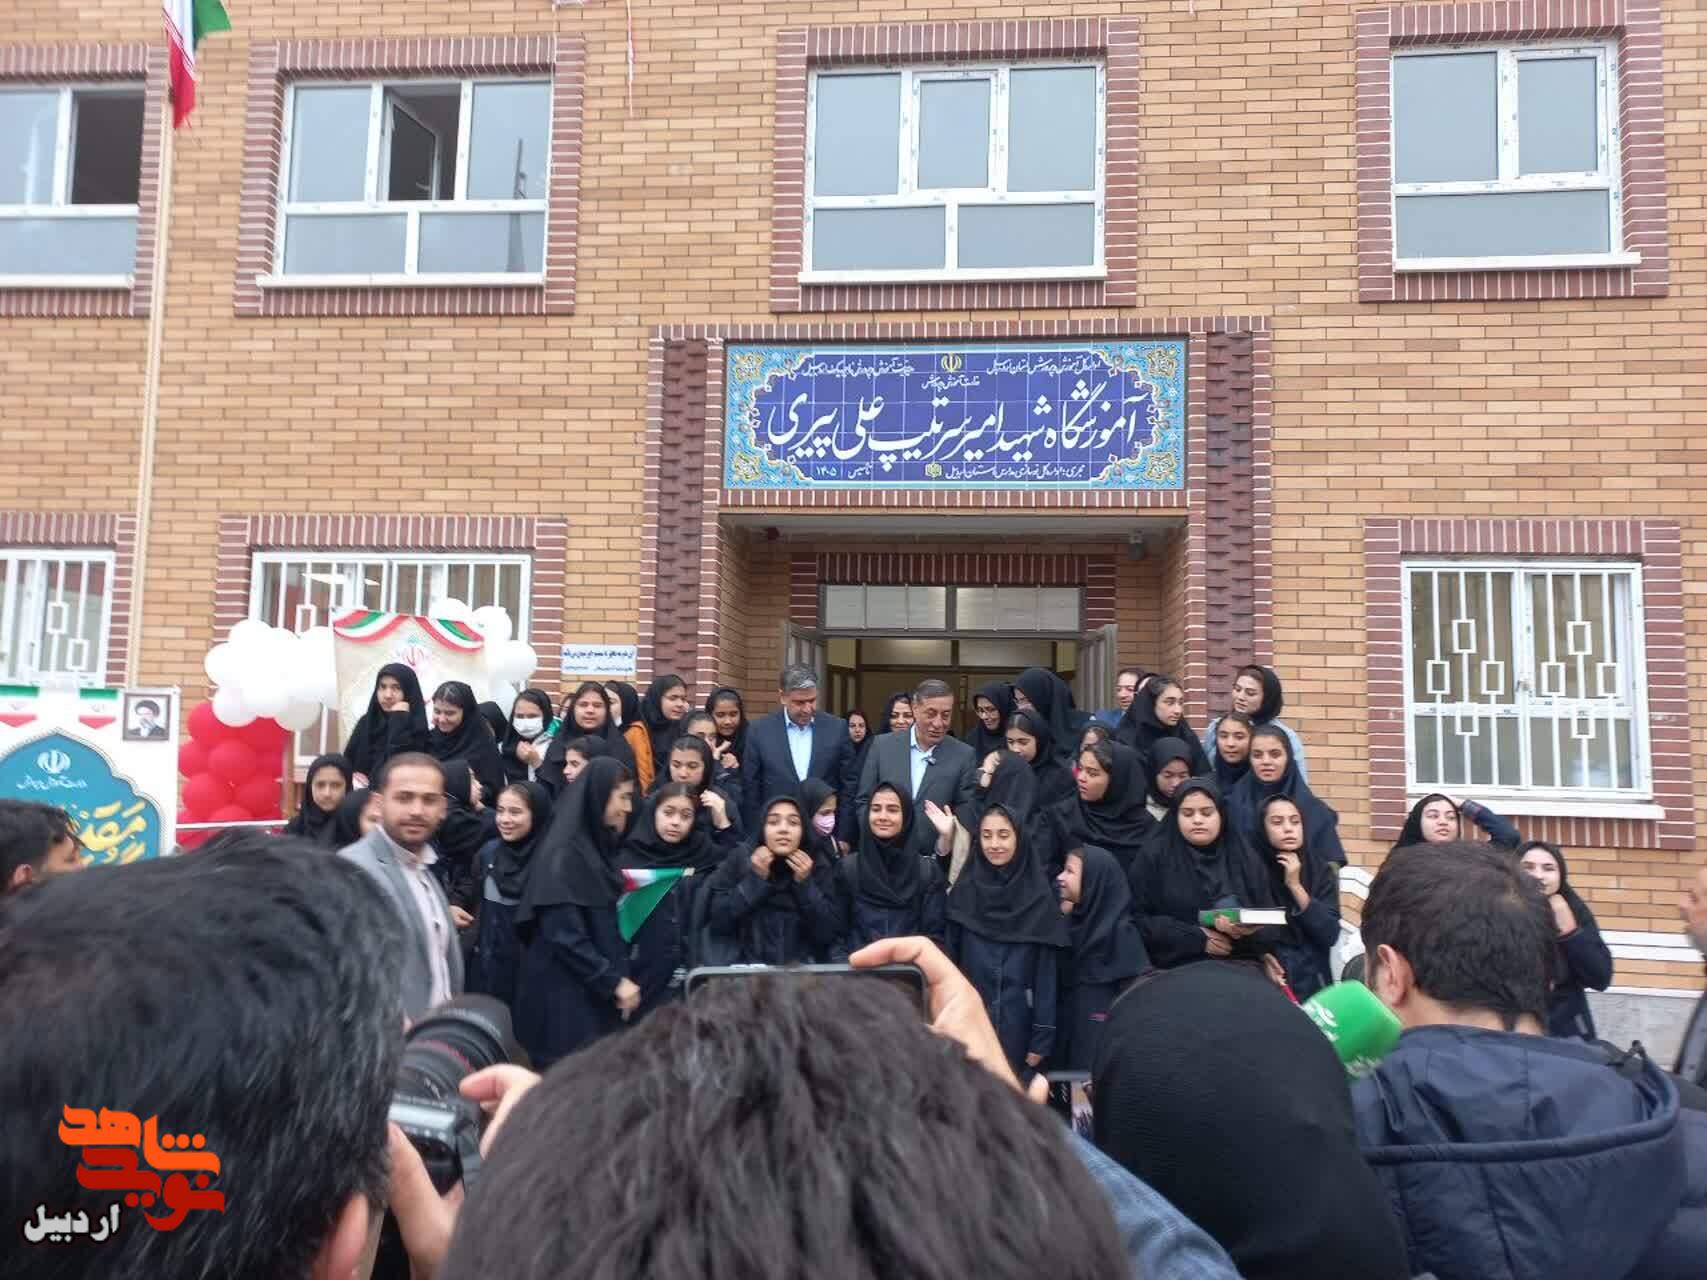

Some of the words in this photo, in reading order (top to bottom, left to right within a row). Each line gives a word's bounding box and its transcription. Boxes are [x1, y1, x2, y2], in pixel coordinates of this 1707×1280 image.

[1027, 356, 1053, 377] پرورش
[1056, 355, 1083, 374] آموزش
[768, 393, 838, 459] پیری
[832, 396, 885, 460] علی
[938, 401, 1004, 462] امیر
[985, 394, 1053, 463] شهید
[1044, 381, 1149, 451] آموزشگاه
